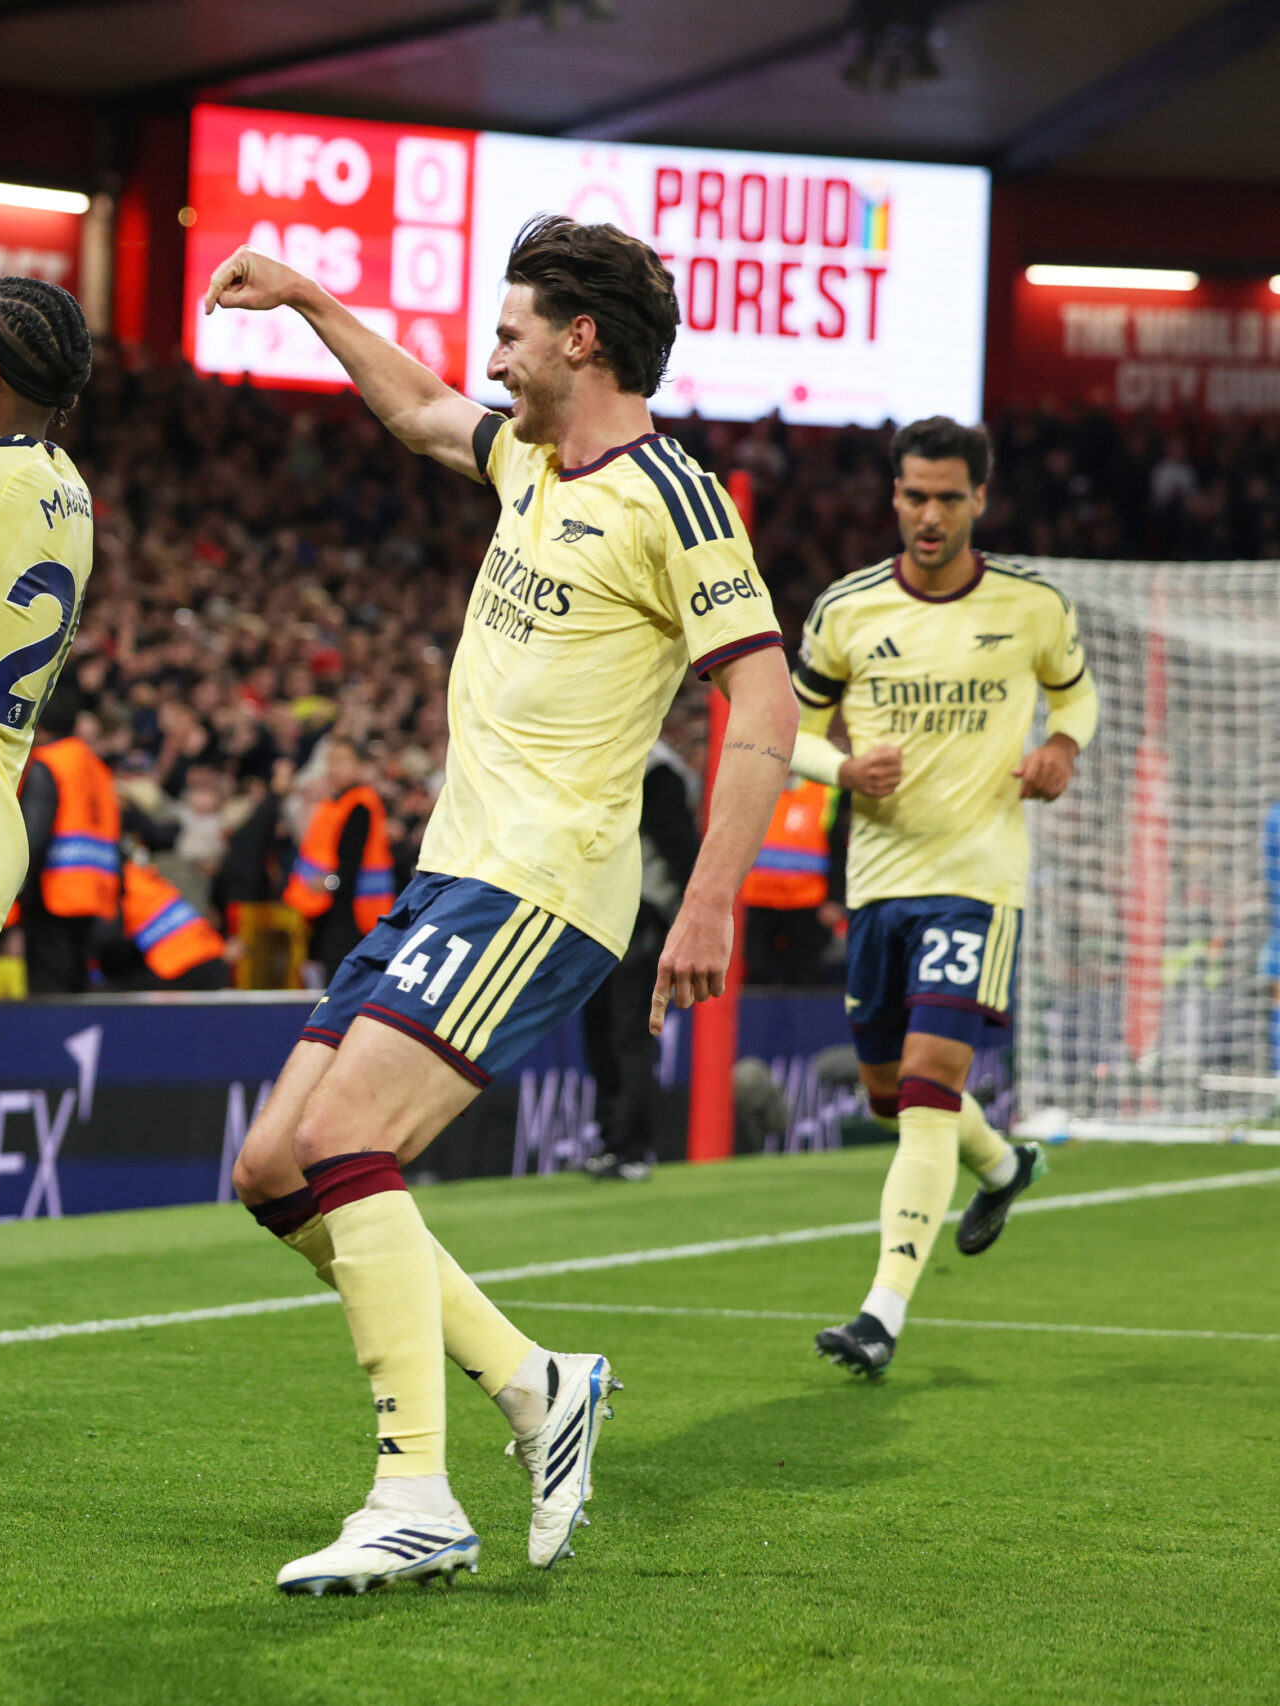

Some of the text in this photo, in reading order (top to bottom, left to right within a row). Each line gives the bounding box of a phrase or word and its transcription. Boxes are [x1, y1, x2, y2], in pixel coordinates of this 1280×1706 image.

[237, 129, 370, 205] NFO
[411, 158, 449, 204] 0
[653, 168, 850, 248] PROUD
[408, 244, 447, 293] 0
[658, 253, 887, 341] OREST
[484, 532, 574, 616] mirates
[690, 569, 763, 617] deel.
[485, 593, 536, 645] BETTER
[869, 674, 1008, 707] Emirates
[890, 708, 988, 734] FLY BETTER
[384, 923, 474, 1007] 41
[918, 927, 985, 986] 23
[375, 1397, 397, 1414] FC
